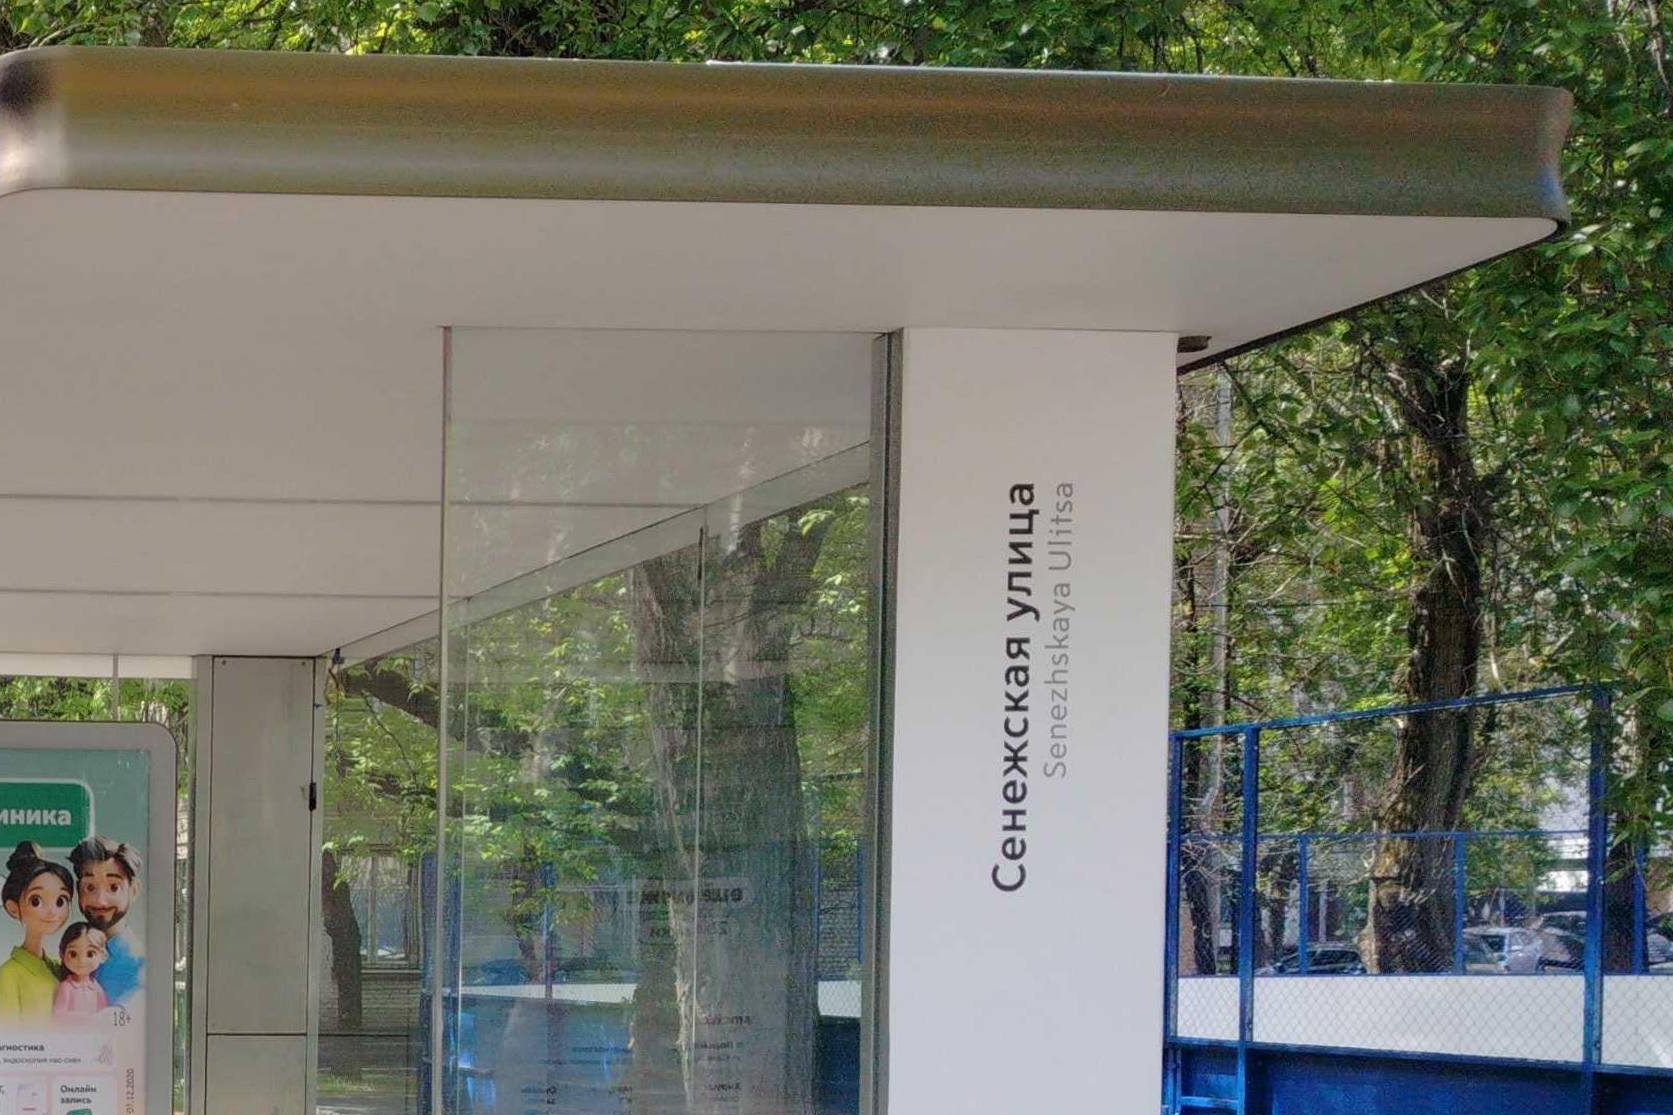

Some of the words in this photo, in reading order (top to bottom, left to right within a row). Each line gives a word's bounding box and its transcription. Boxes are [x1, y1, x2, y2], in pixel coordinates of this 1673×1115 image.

[1006, 483, 1041, 622] улица
[1047, 482, 1073, 570] Ulitsa
[1043, 583, 1076, 778] Senezhskaya
[991, 636, 1030, 892] Сенежская
[113, 1010, 132, 1027] 18+
[60, 1084, 97, 1094] Онлайн
[60, 1097, 93, 1106] запись
